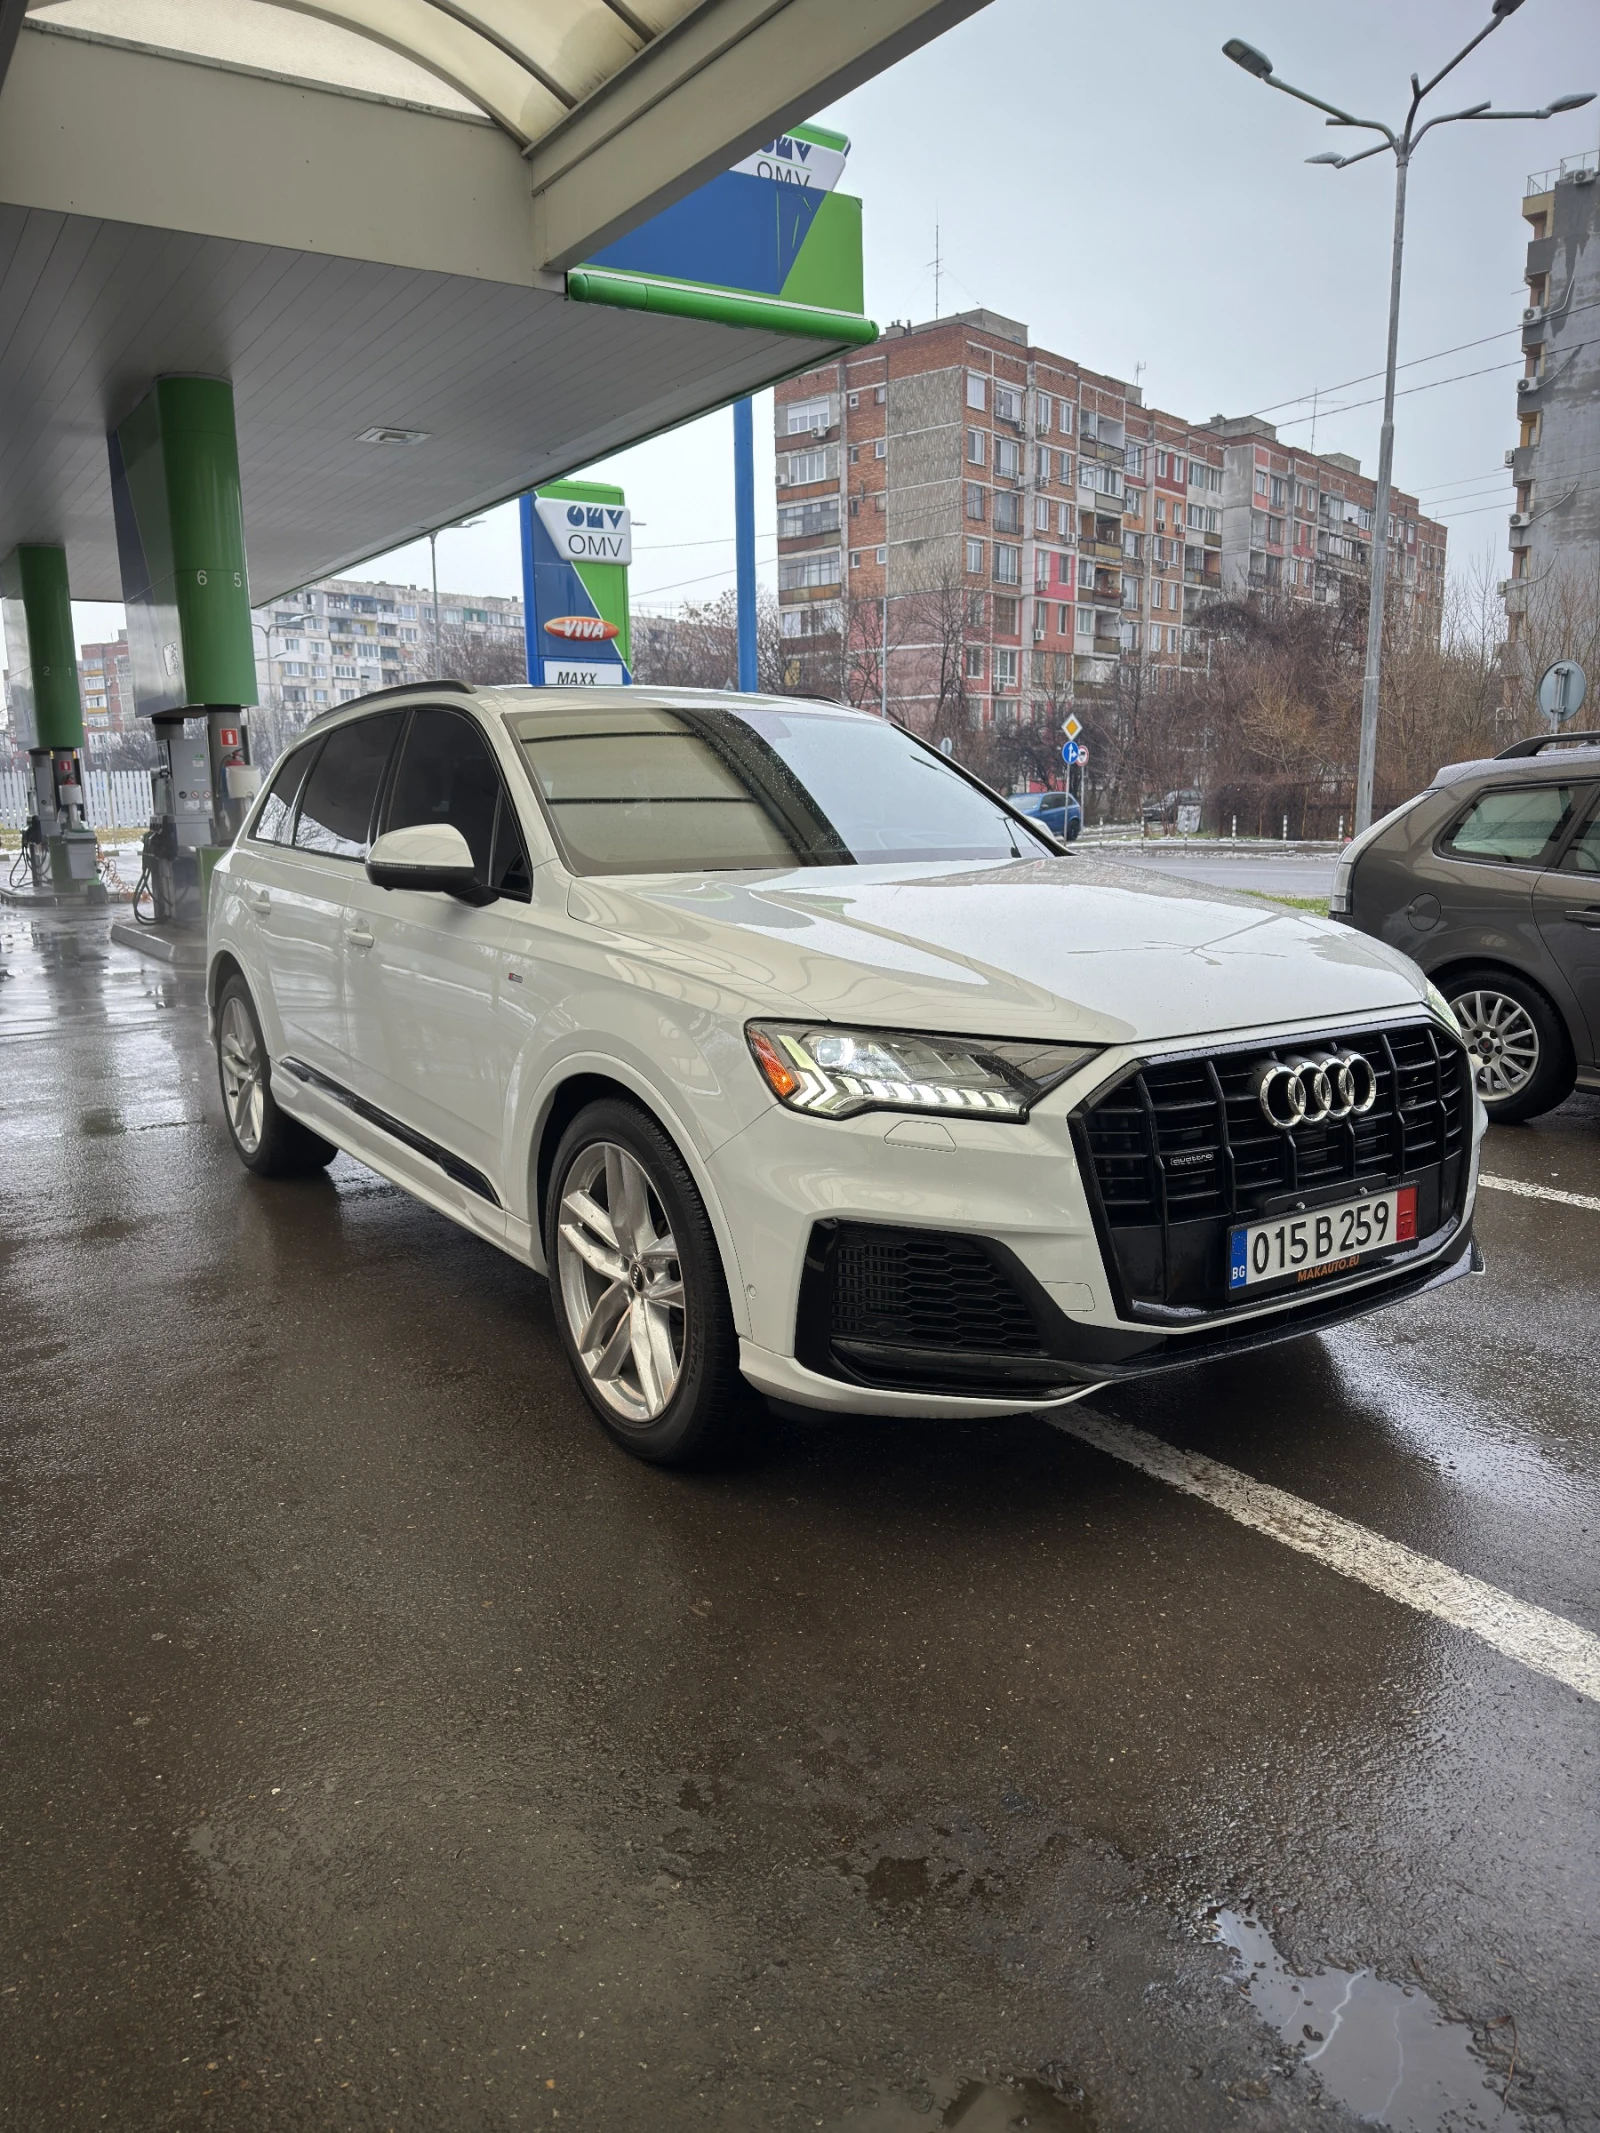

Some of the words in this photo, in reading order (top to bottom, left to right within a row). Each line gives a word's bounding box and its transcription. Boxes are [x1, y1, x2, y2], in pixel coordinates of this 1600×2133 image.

[757, 161, 810, 187] OMV
[568, 534, 623, 557] OMV
[197, 570, 207, 585] 6
[234, 572, 241, 587] 5
[564, 619, 605, 638] VIVA
[43, 666, 50, 676] 2
[68, 667, 72, 676] 1
[557, 671, 597, 685] MAXX
[1172, 1153, 1213, 1166] quattro
[1232, 1265, 1246, 1280] BG
[1297, 1254, 1360, 1282] MAKAUTO.EU
